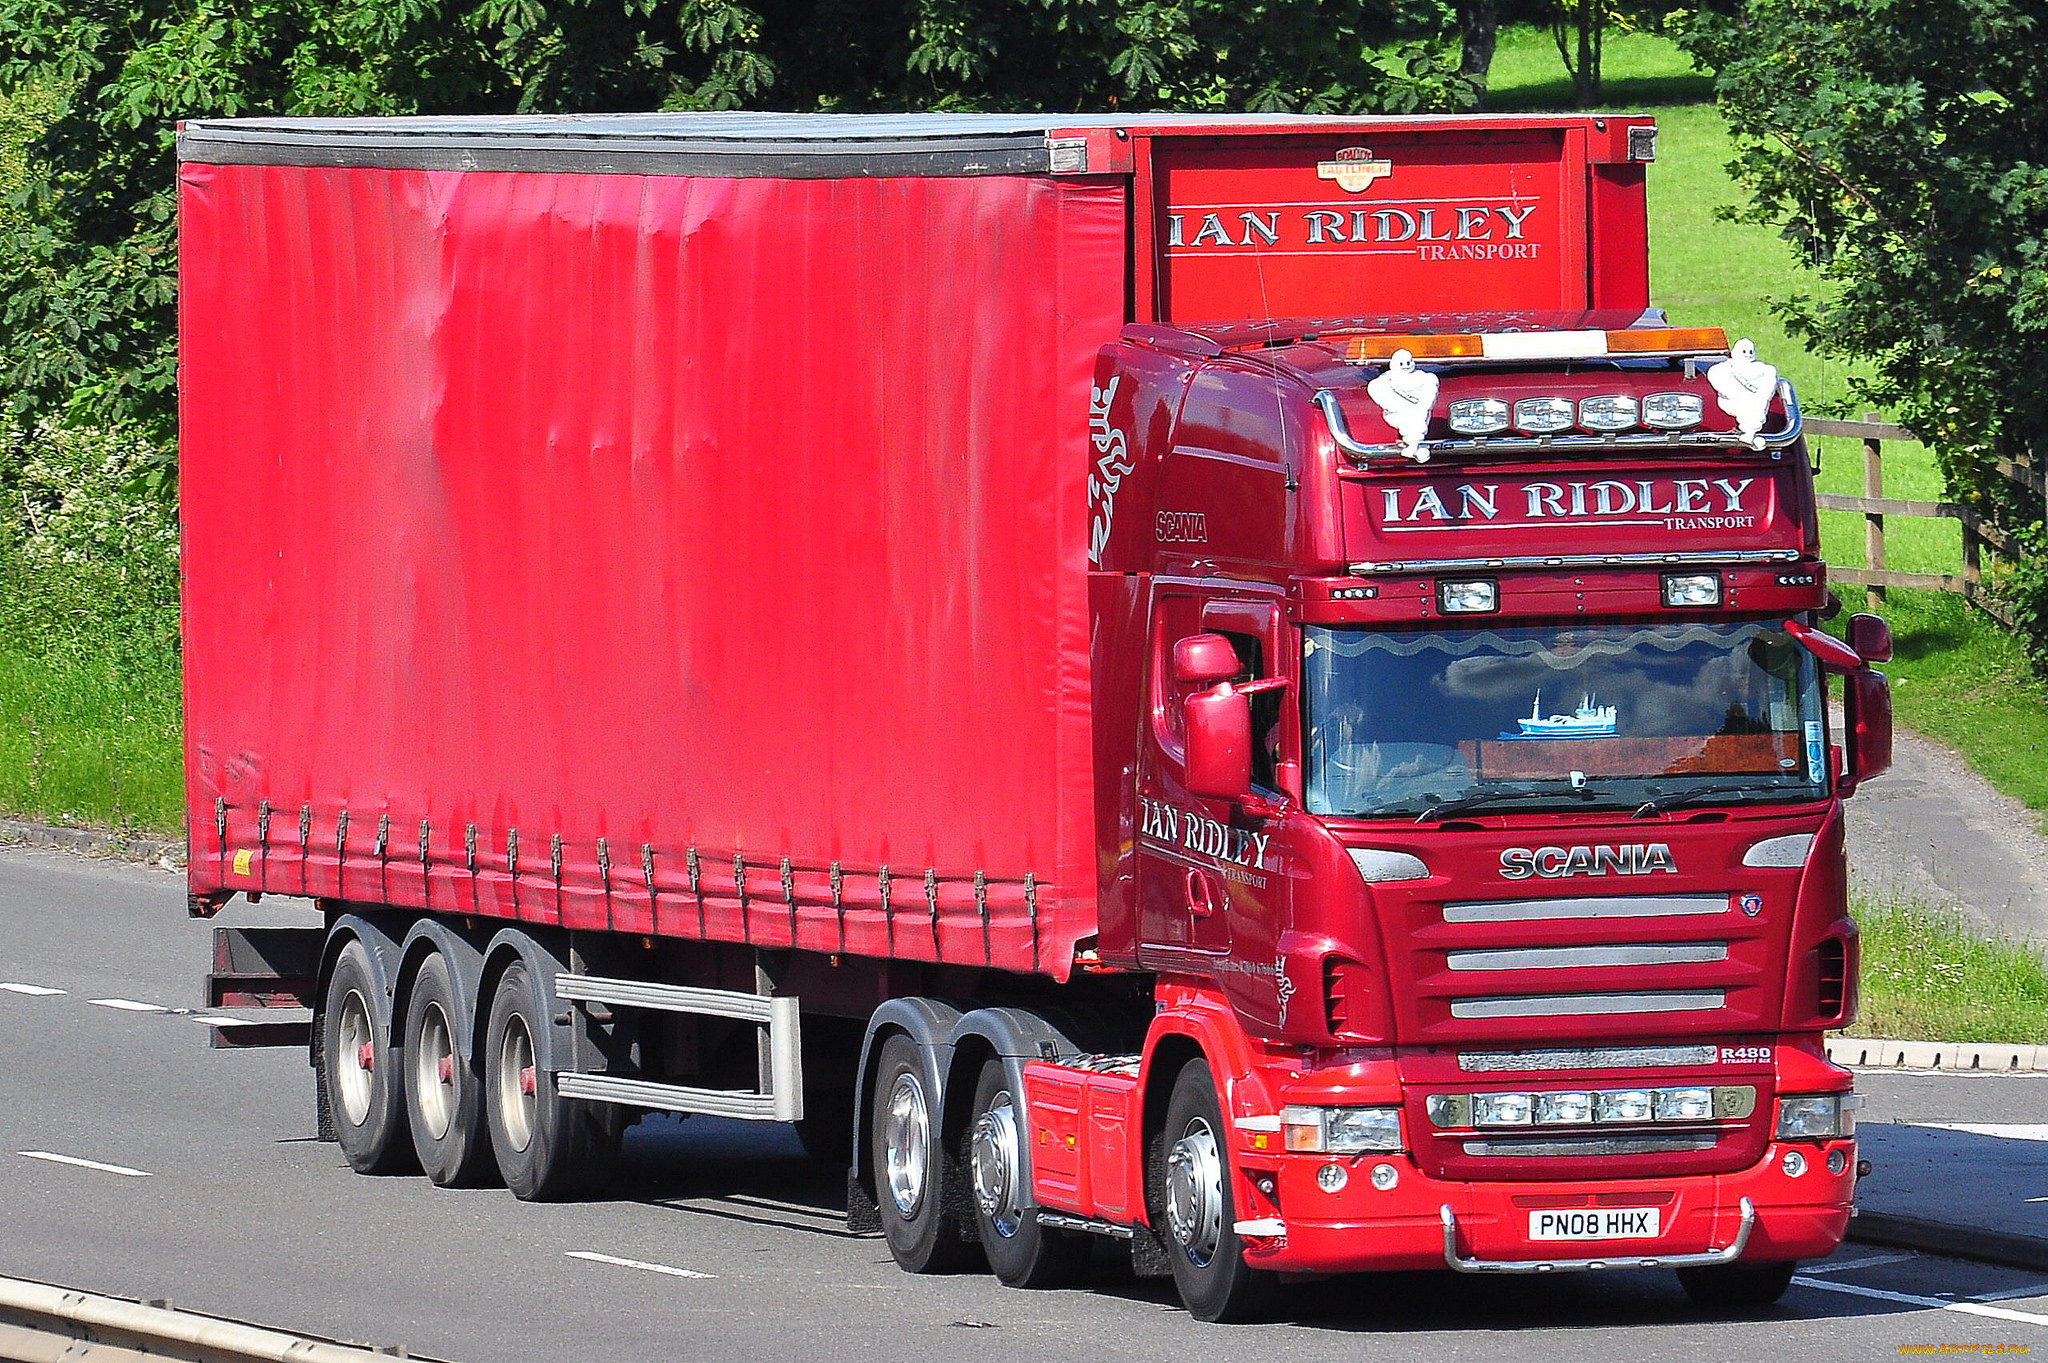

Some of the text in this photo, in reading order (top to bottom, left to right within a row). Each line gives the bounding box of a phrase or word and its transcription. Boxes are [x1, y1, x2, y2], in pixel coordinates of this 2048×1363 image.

[1166, 205, 1537, 247] IAN RIDLEY
[1417, 244, 1541, 261] TRANSPORT
[1382, 477, 1754, 523] IAN RIDLEY
[1155, 510, 1208, 543] SCANIA
[1664, 515, 1755, 532] TRANSPORT
[1140, 798, 1270, 870] IAN RIDLEY
[1499, 842, 1679, 880] SCANIA
[1227, 867, 1267, 890] TRANSPORT
[1721, 1047, 1771, 1058] R480
[1541, 1211, 1649, 1236] PN08 HHX
